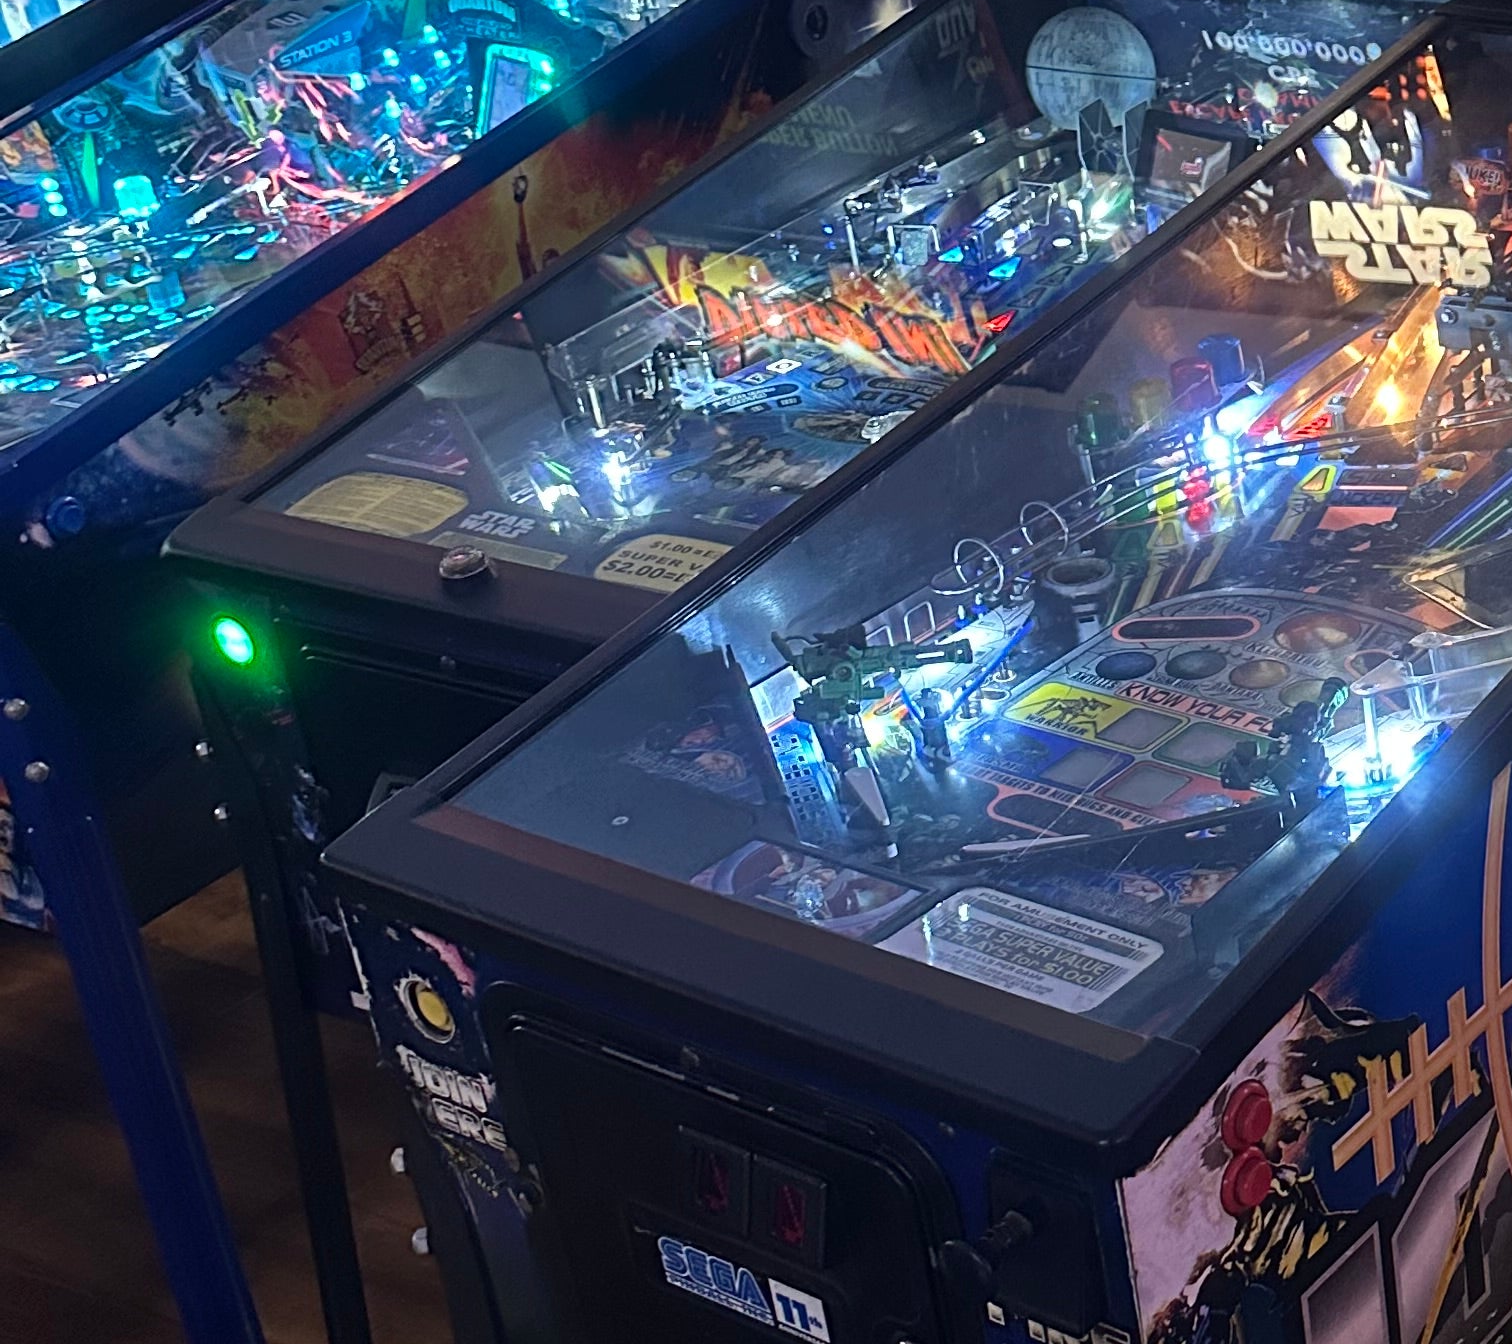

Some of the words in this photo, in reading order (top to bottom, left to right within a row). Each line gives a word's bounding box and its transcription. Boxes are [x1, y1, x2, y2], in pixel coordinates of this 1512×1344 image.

[280, 32, 340, 68] STATION
[342, 29, 353, 45] 3
[458, 518, 533, 540] WARS
[478, 509, 536, 530] STAR
[617, 550, 684, 567] SUPER
[650, 541, 693, 554] $1.00
[1120, 682, 1187, 708] KNOW
[1191, 700, 1249, 727] YOUR
[1024, 714, 1089, 737] WARRIOR
[978, 891, 1010, 906] FOR
[1106, 932, 1149, 950] ONLY
[952, 931, 1010, 960] PLAYS
[1010, 949, 1041, 968] for
[1040, 960, 1097, 986] $1.00
[999, 929, 1052, 957] SUPER
[1054, 947, 1111, 976] VALUE
[658, 1236, 772, 1314] SEGA
